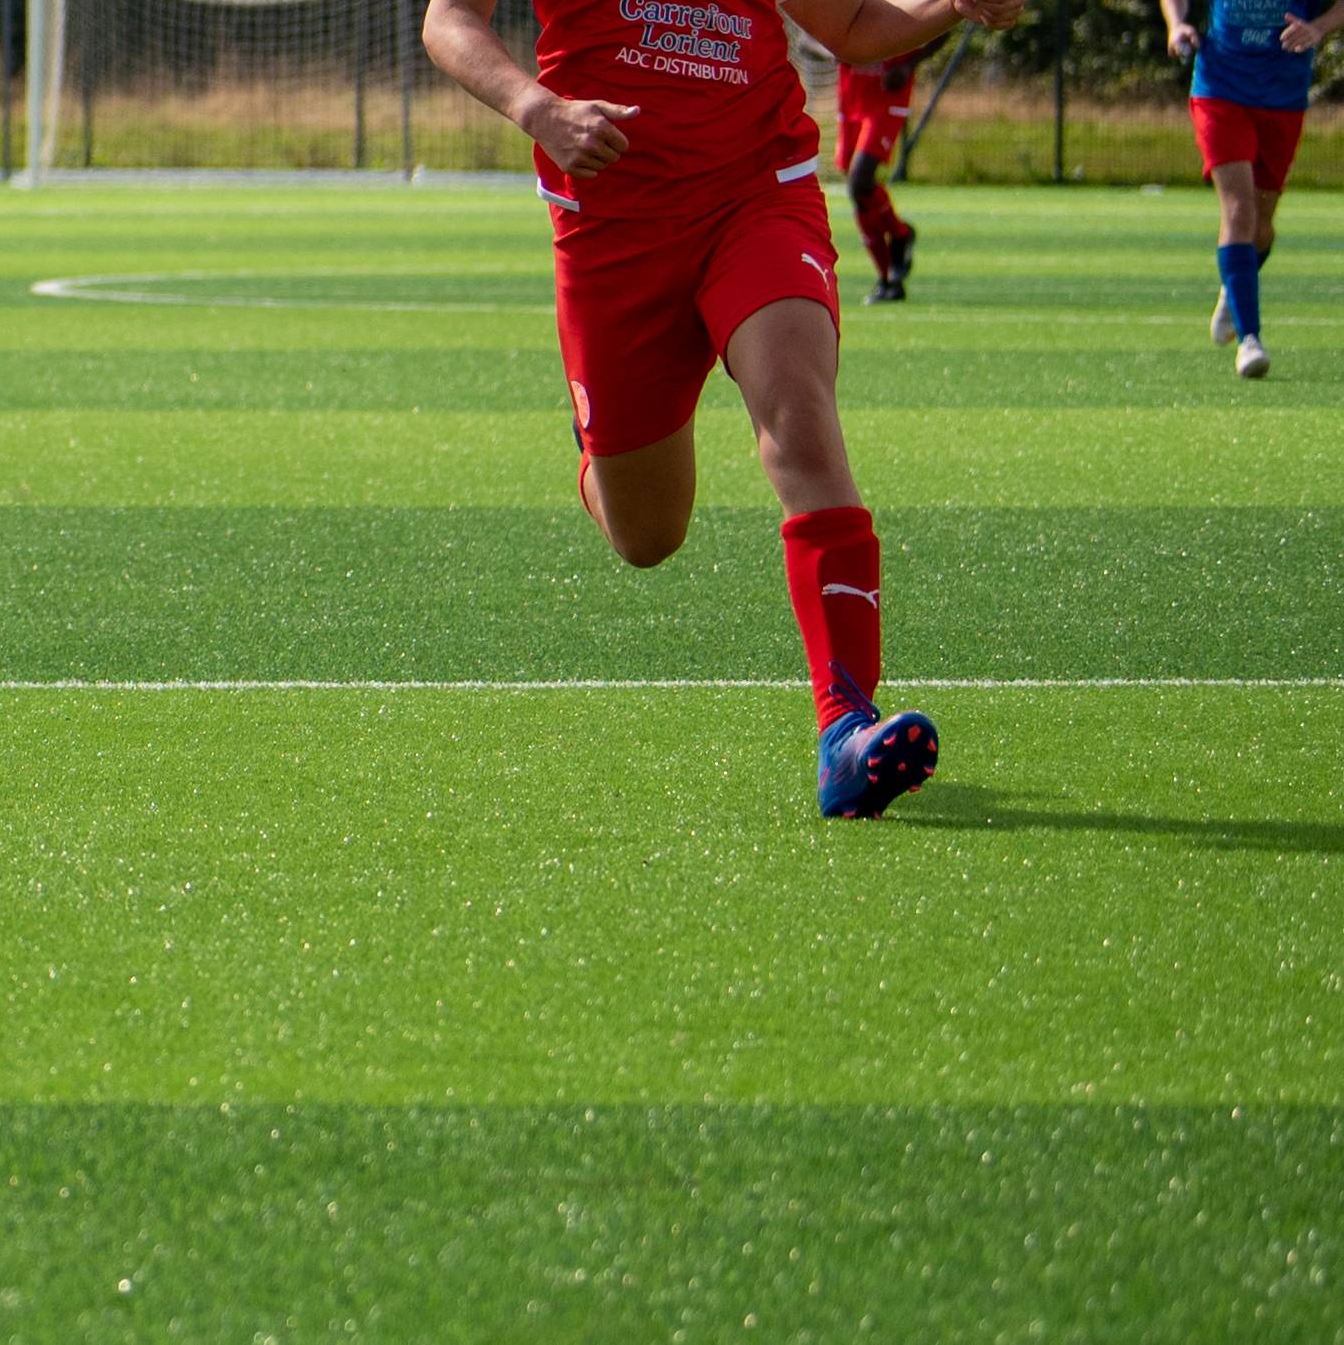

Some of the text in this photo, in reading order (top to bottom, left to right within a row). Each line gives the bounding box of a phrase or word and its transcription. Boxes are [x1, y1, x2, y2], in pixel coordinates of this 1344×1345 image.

[639, 22, 741, 63] Lorient
[615, 47, 750, 84] ADC DISTRIBUTION
